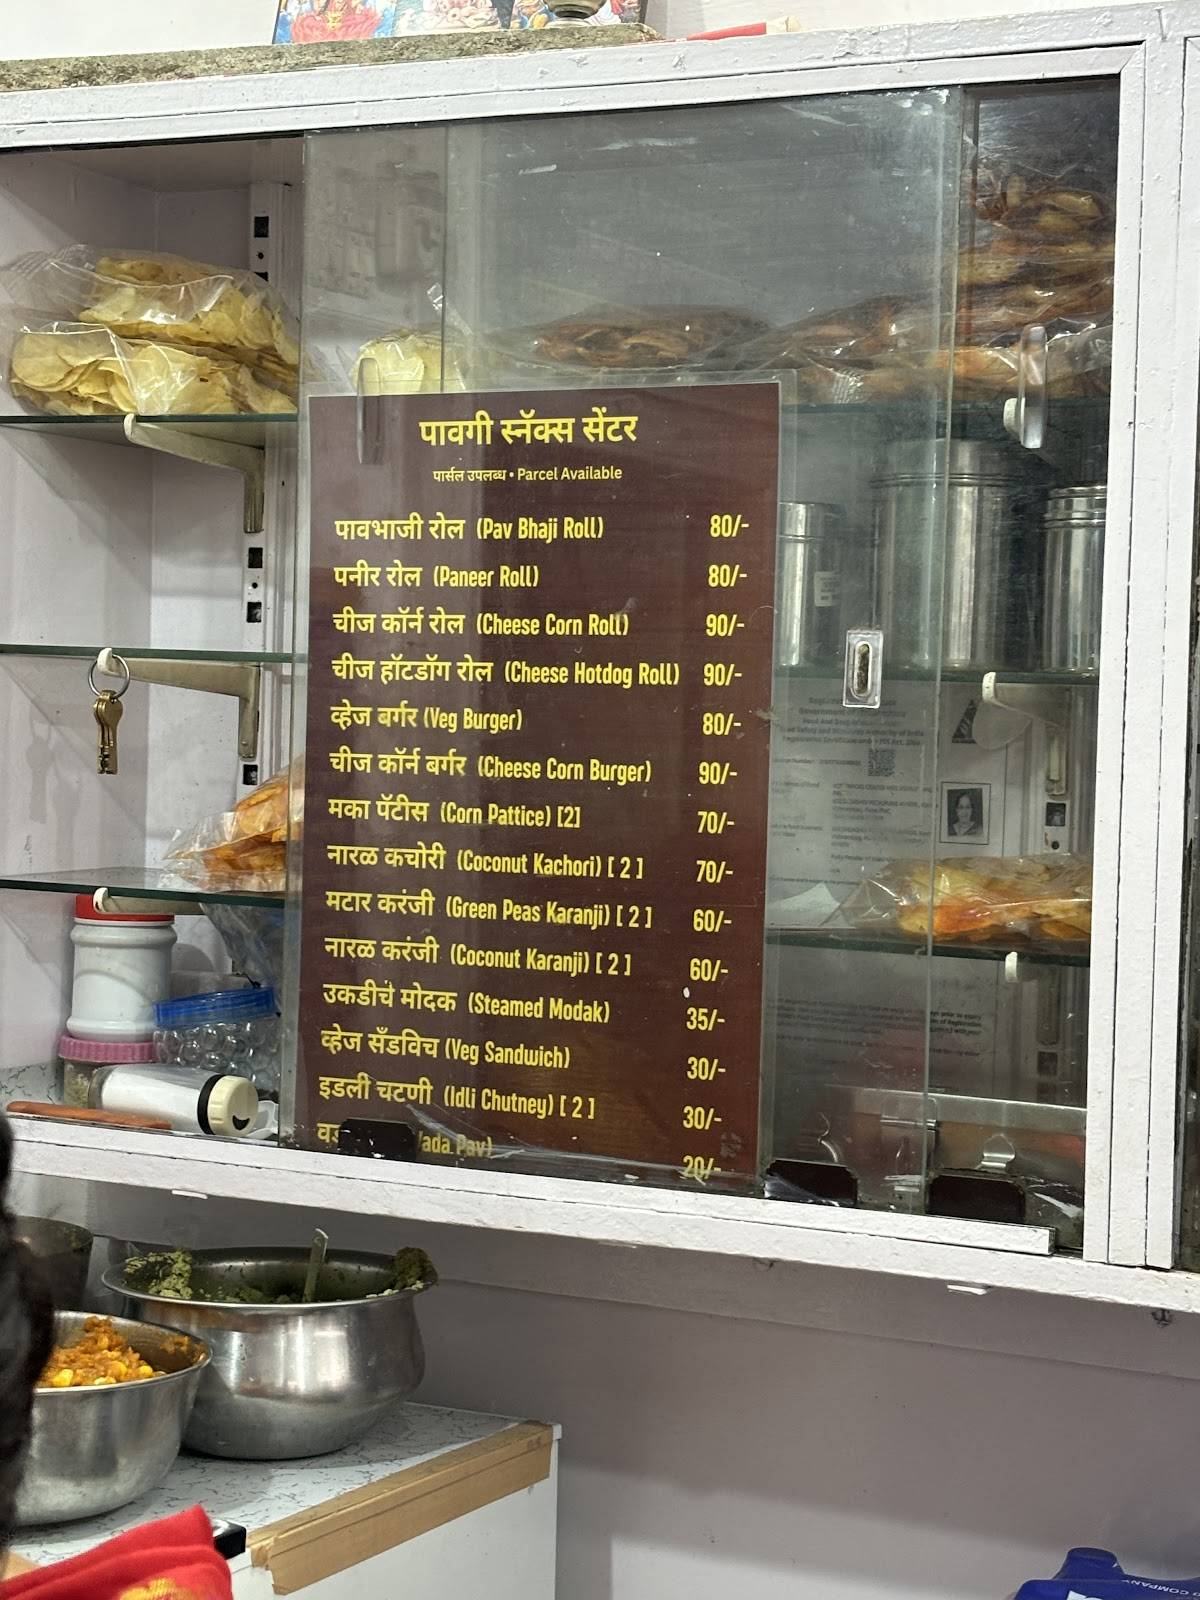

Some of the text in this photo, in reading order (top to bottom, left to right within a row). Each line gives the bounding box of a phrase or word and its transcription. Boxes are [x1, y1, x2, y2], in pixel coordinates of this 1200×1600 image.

[418, 406, 639, 447] पावगी स्नॅक्स सेंटर
[432, 466, 623, 482] पार्सल उपलब्ध Parcel Available
[334, 511, 750, 545] पावभाजी रोल (Pav Bhaji Roll) 80/-
[333, 559, 748, 588] पनीर रोल (Paneer Roll) 80/-
[332, 605, 746, 637] चीज कॉर्न रोल (Cheese Corn Roll) 90/-
[331, 652, 744, 690] चीज हॉटडॉग रोल (Cheese Hotdog Roll) 90/-
[329, 698, 743, 736] व्हेज बर्गर (Veg Burger) 80/-
[328, 745, 739, 787] चीज कॉर्न बर्गर (Cheese Corn Burger) 90/-
[327, 793, 735, 835] मका पॅटीस (Corn Pattice) [2] 70/-
[326, 844, 380, 866] नारळ
[383, 840, 448, 870] कचोरी
[456, 848, 528, 874] (Coconut
[533, 852, 602, 878] Kachori)
[696, 859, 734, 884] 70/-
[325, 890, 373, 913] मटार
[376, 888, 436, 917] करंजी
[445, 895, 498, 920] (Green
[502, 898, 541, 923] Peas
[546, 900, 611, 931] Karanji)
[693, 908, 732, 933] 60/-
[324, 936, 377, 959] नारळ
[380, 935, 440, 964] करंजी
[450, 943, 521, 969] (Coconut
[526, 947, 590, 977] Karanji)
[689, 957, 729, 982] 60/-
[399, 981, 458, 1013] मोदक
[467, 991, 544, 1019] (Steamed
[548, 997, 610, 1024] Modak)
[686, 1006, 725, 1031] 35/-
[321, 1023, 364, 1055] व्हेज
[444, 1037, 480, 1066] (Veg
[484, 1040, 571, 1069] Sandwich)
[687, 1056, 727, 1081] 30/-
[319, 1071, 372, 1100] इडली
[375, 1076, 434, 1104] चटणी
[443, 1086, 477, 1109] (Idli
[481, 1088, 554, 1120] Chutney)
[682, 1105, 722, 1130] 30/-
[419, 1131, 451, 1154] ada
[456, 1133, 493, 1157] Pav)
[682, 1154, 722, 1180] 20/-
